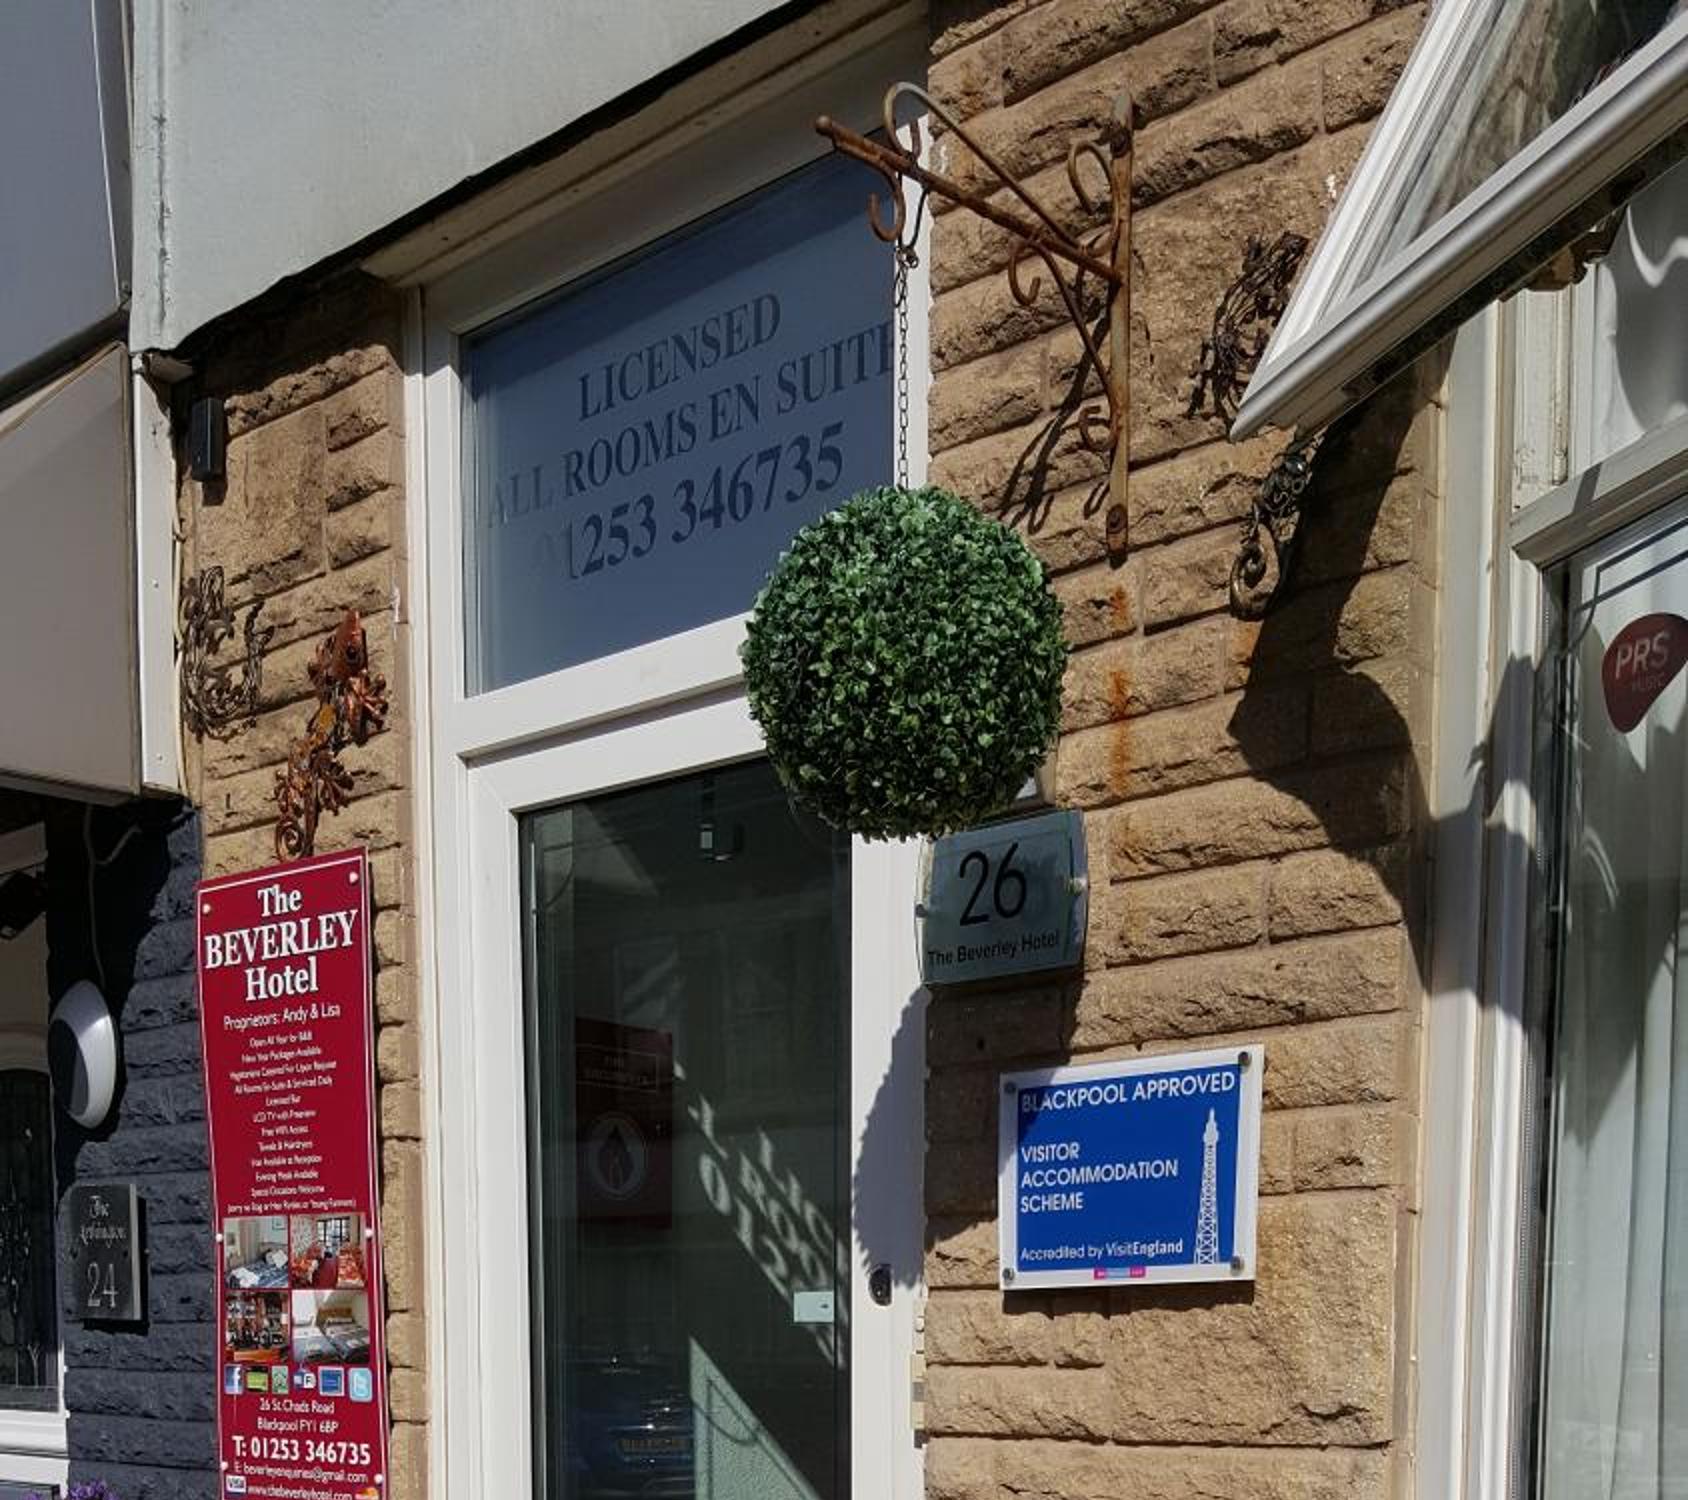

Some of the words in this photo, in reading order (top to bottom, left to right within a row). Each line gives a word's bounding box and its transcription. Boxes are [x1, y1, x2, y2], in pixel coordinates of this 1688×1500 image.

[577, 292, 782, 421] LICENSED
[563, 402, 697, 497] ROOMS
[708, 375, 760, 442] EN
[671, 420, 845, 545] 346735
[1615, 631, 1670, 680] PRS
[258, 883, 302, 917] The
[958, 842, 1027, 926] 26
[204, 909, 358, 969] BEVERLEY
[928, 950, 953, 966] The
[957, 941, 1017, 961] Beverley
[1022, 929, 1059, 952] Hotel
[244, 956, 319, 1001] Hotel
[283, 1005, 308, 1024] Andy
[310, 1003, 318, 1019] &
[321, 1002, 340, 1018] Lisa
[1022, 1084, 1127, 1113] BLACKPOOL
[1131, 1071, 1235, 1102] APPROVED
[1021, 1142, 1080, 1163] VISITOR
[1021, 1159, 1178, 1188] ACCOMMODATION
[1020, 1192, 1084, 1213] SCHEME
[1020, 1243, 1085, 1261] Accredited
[1087, 1244, 1102, 1259] by
[88, 1262, 119, 1307] 24
[259, 1398, 270, 1411] 26
[311, 1400, 335, 1414] Road
[257, 1416, 298, 1434] Blackpool
[231, 1435, 247, 1457] T:
[251, 1436, 300, 1461] 01253
[305, 1439, 371, 1465] 346735
